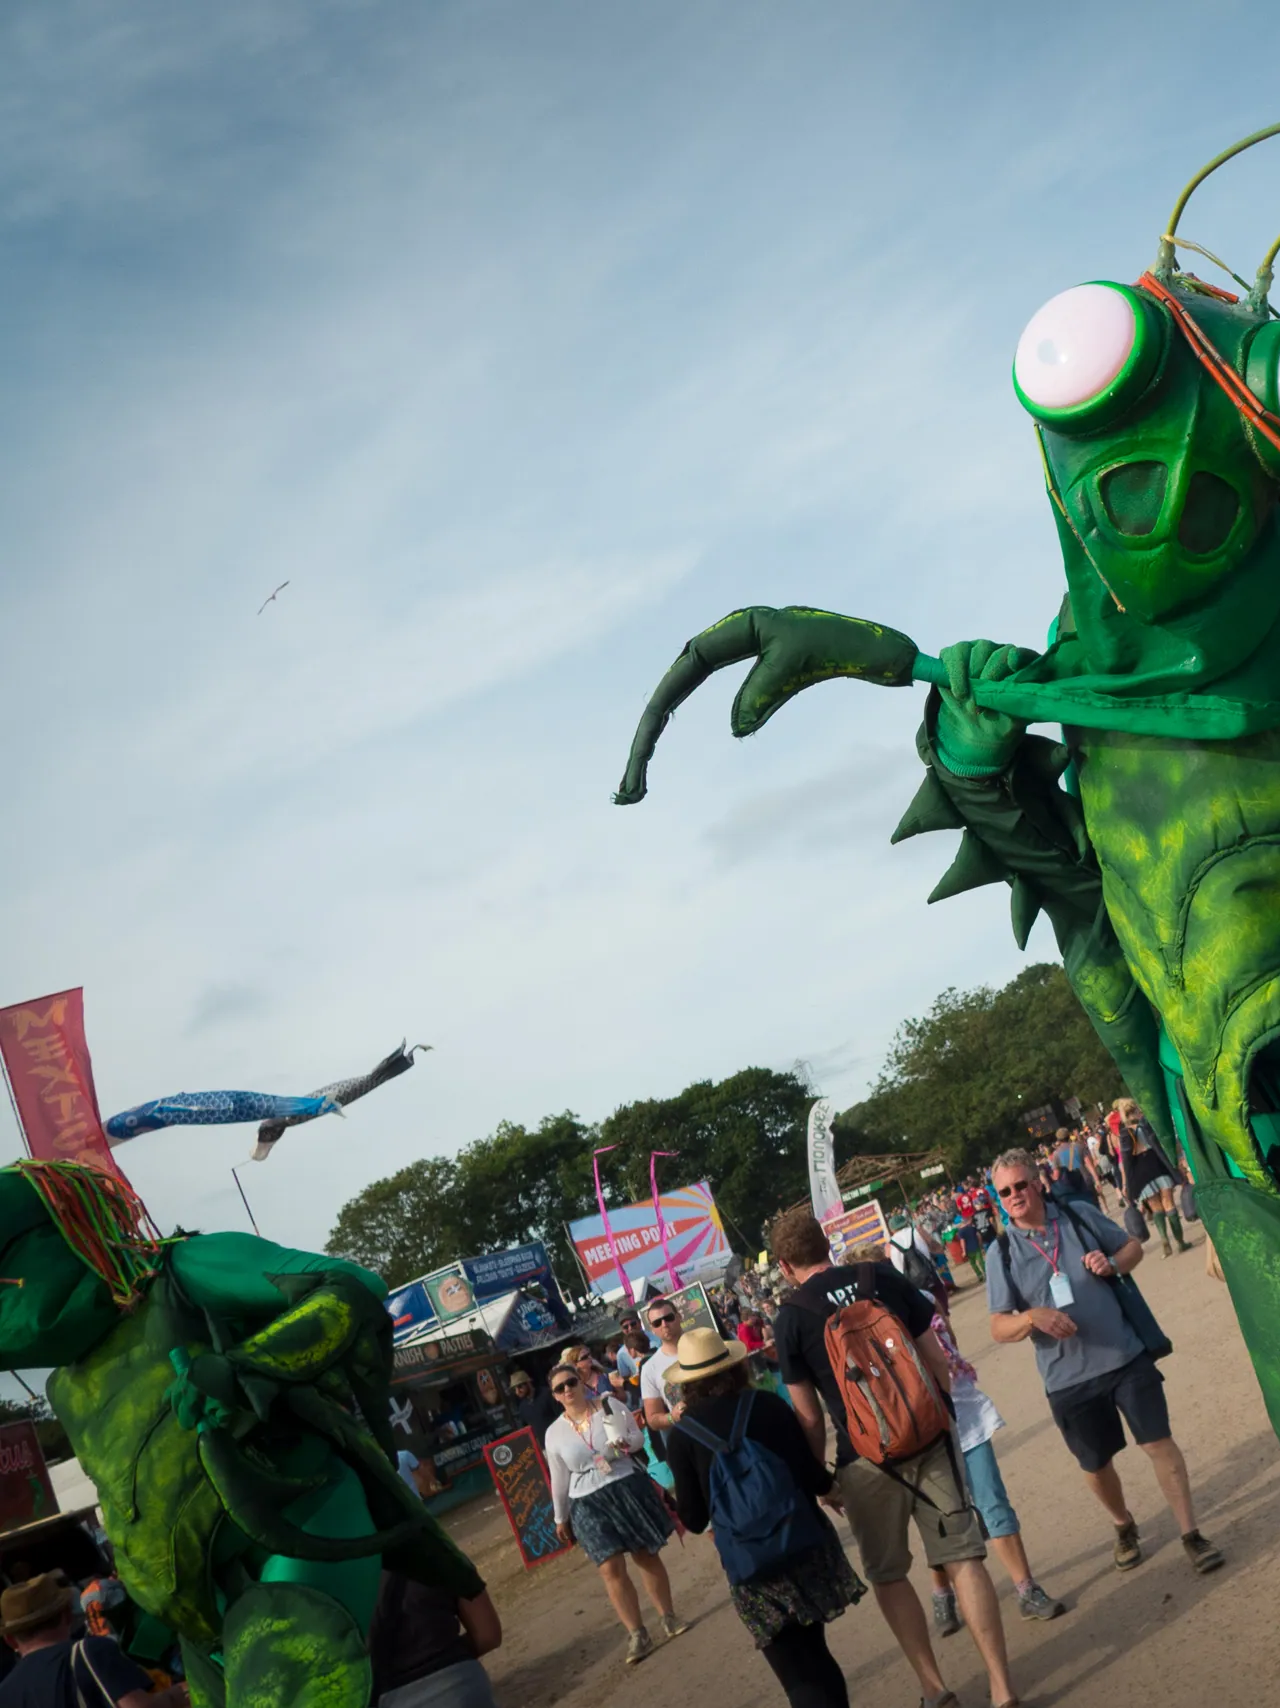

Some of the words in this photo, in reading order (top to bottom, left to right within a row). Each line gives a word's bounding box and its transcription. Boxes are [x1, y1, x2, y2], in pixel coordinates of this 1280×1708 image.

[583, 1233, 641, 1266] MEETING
[394, 1347, 425, 1367] RNISH
[440, 1333, 474, 1355] PASTIES
